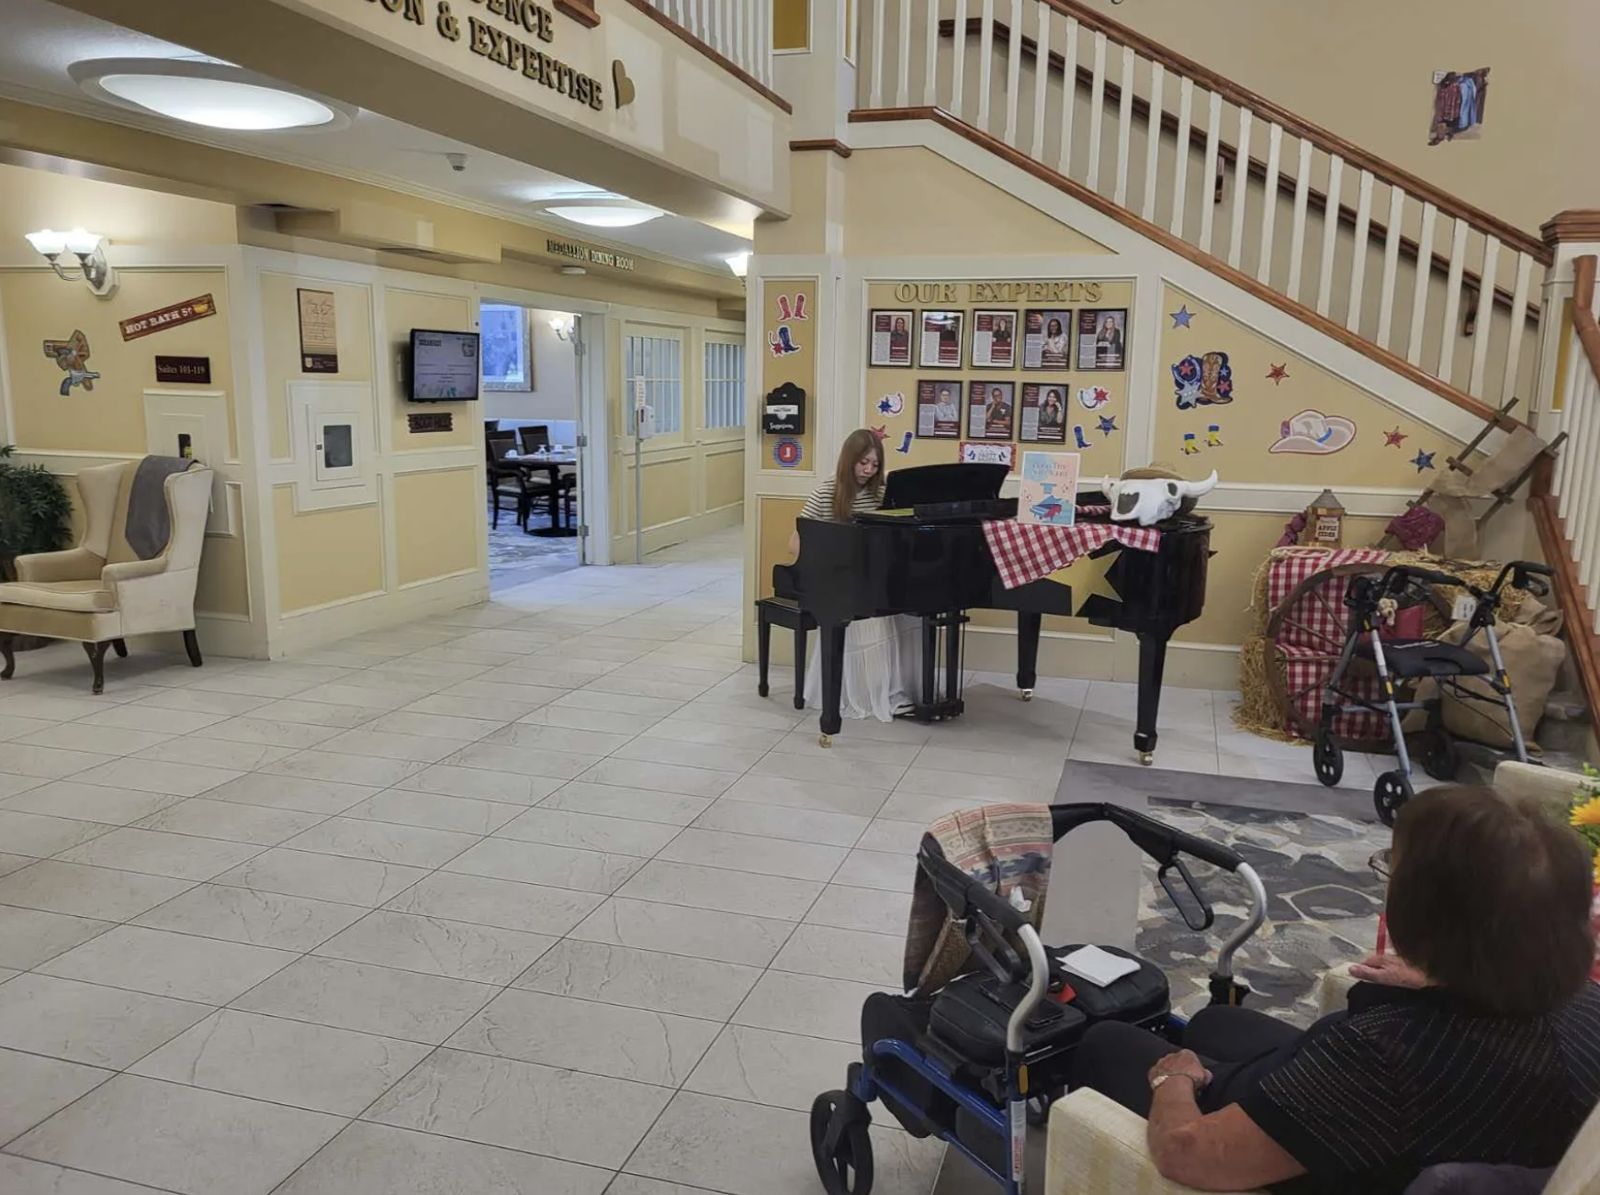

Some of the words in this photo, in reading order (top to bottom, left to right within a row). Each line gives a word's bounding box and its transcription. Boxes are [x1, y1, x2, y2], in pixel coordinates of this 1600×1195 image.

[437, 1, 460, 41] &
[469, 16, 603, 111] EXPERTISE
[546, 239, 589, 261] MEDALLION
[590, 249, 613, 266] DINING
[614, 255, 634, 271] ROOM
[895, 283, 957, 303] OUR
[967, 281, 1104, 302] EXPERTS
[125, 320, 149, 334] HOT
[149, 310, 180, 326] BATH
